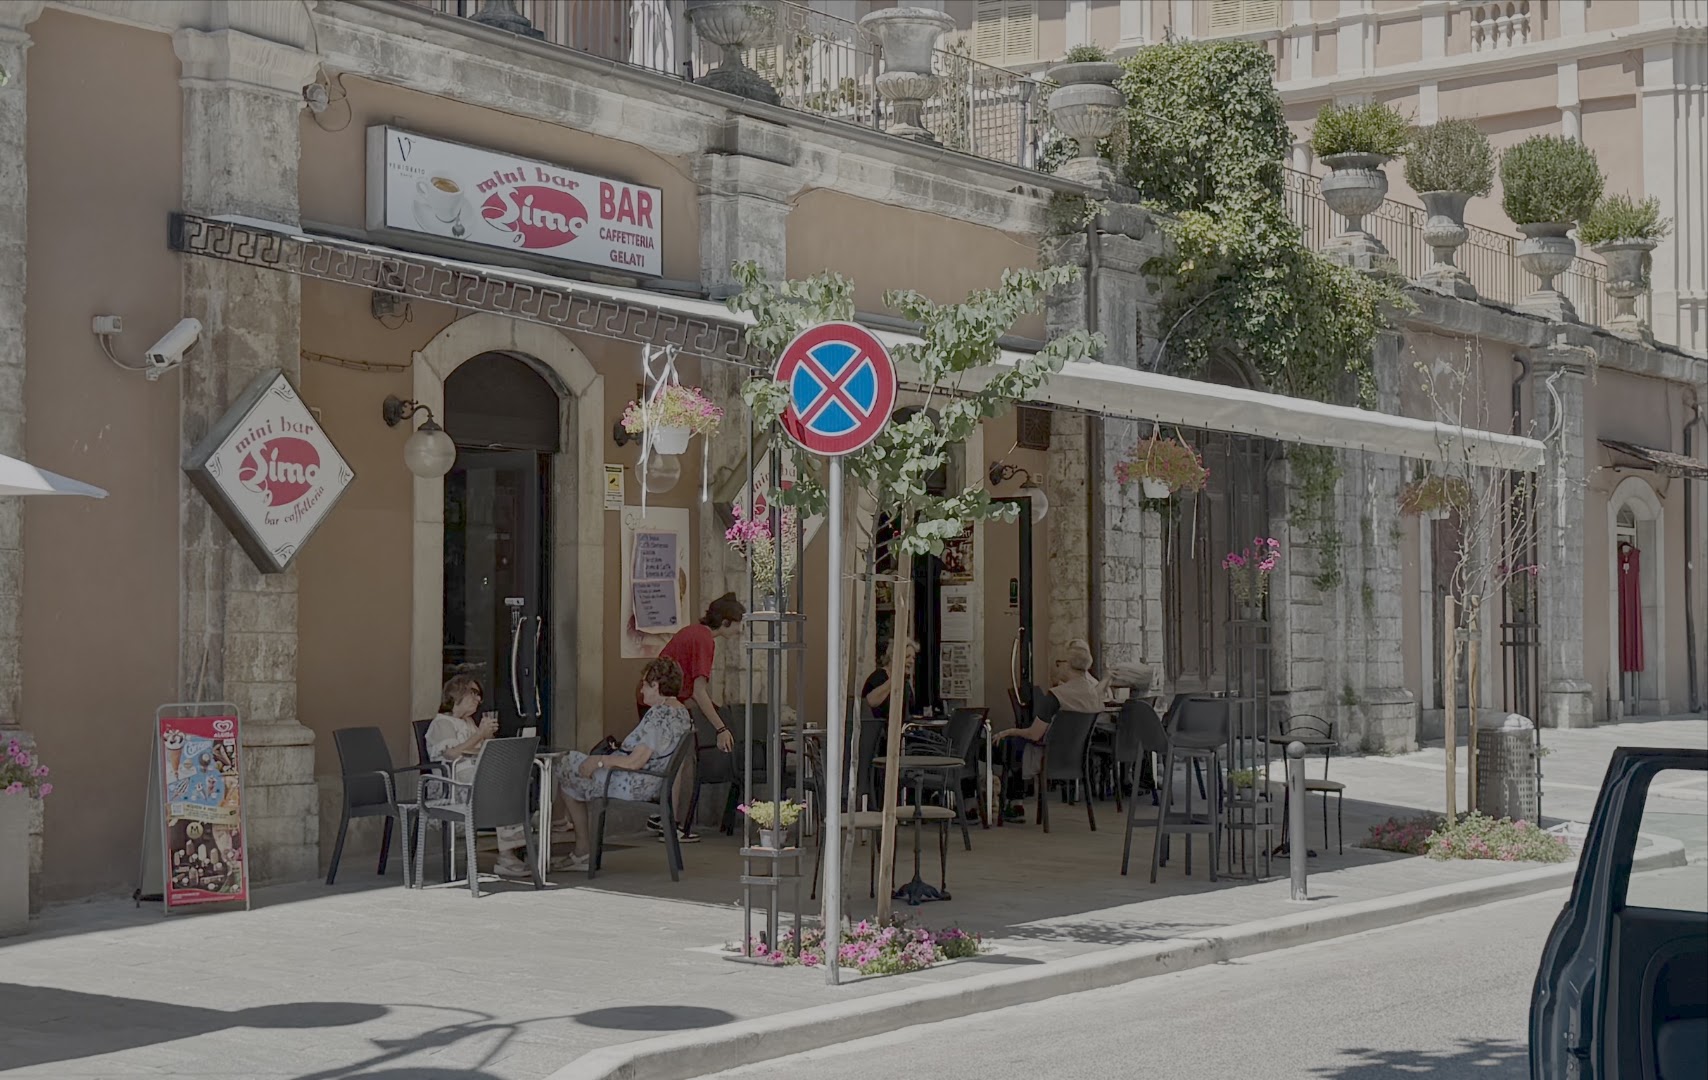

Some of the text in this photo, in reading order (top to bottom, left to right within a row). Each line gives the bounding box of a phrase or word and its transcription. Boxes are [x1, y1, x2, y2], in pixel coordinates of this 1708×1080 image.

[476, 167, 580, 193] mini bar
[483, 186, 589, 238] Simo
[600, 182, 653, 229] BAR
[600, 227, 654, 250] CAFFETTERIA
[610, 250, 645, 268] GELATI
[235, 416, 314, 454] mini bar
[240, 442, 321, 492] Simo
[264, 485, 325, 526] bar caffetteria
